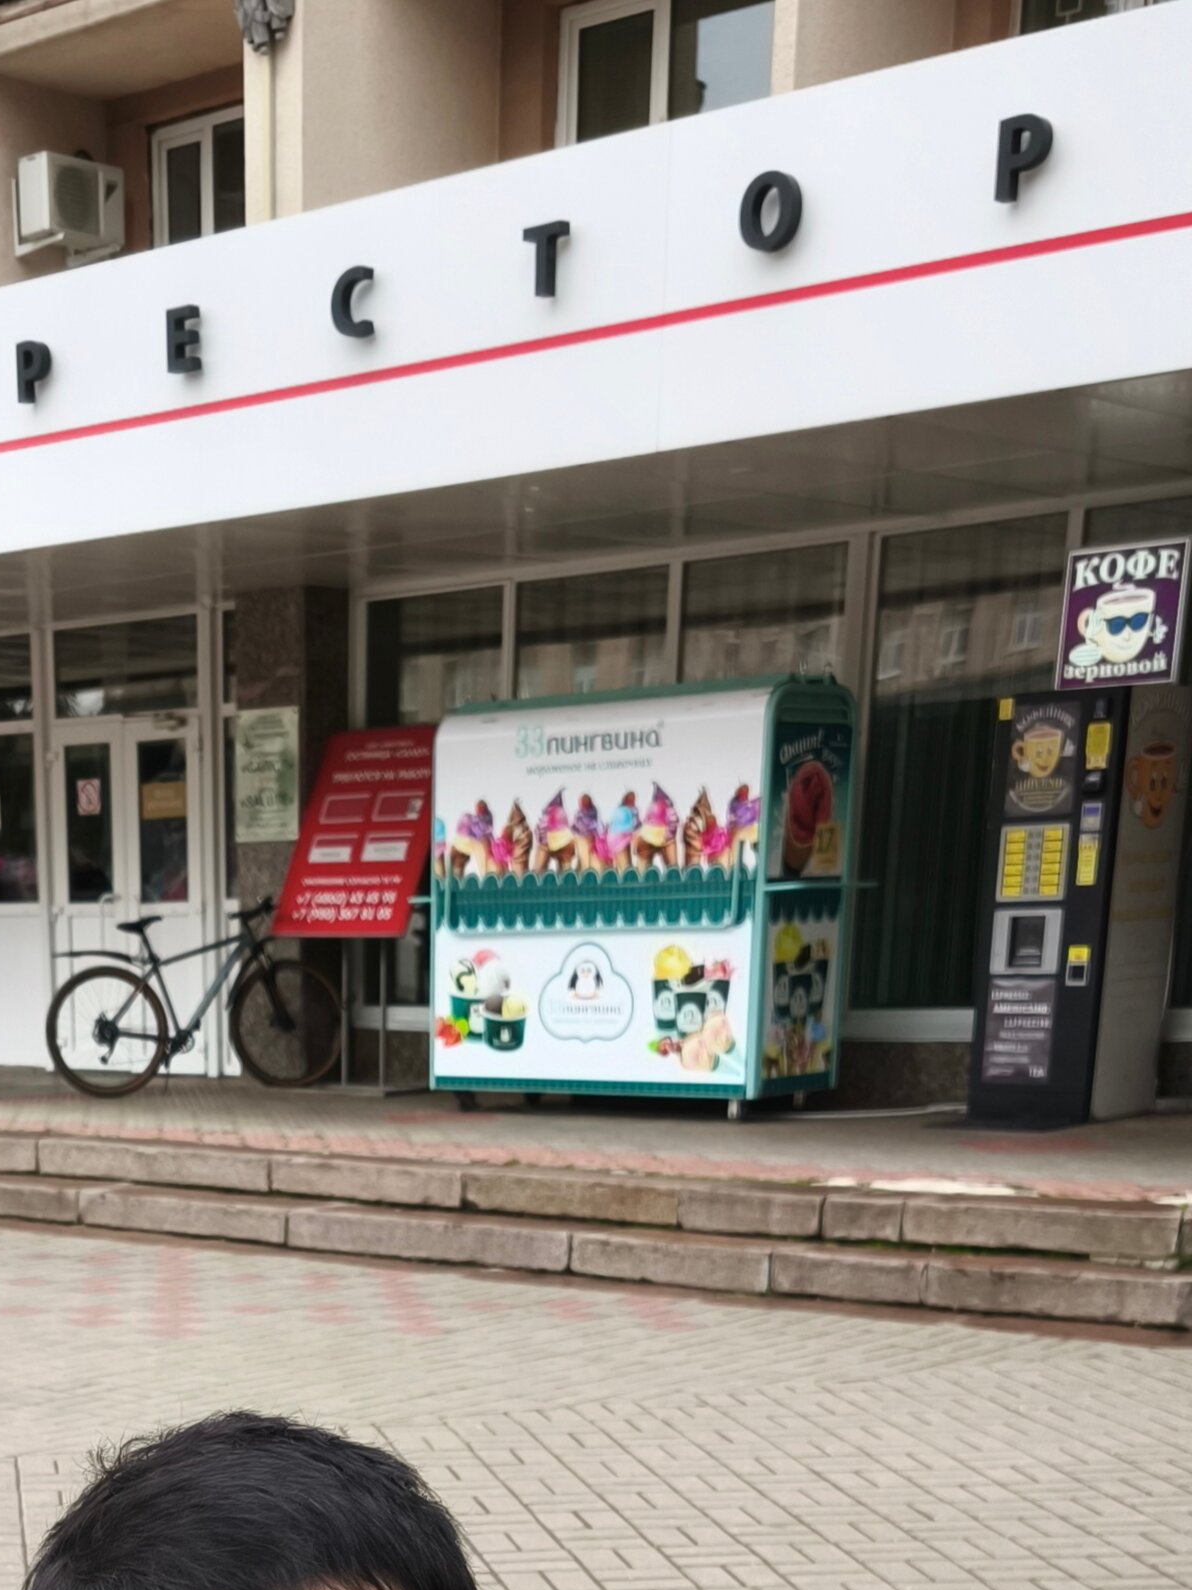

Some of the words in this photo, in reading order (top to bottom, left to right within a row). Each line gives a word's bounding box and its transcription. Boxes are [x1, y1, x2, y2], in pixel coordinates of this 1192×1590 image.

[16, 113, 1053, 404] РЕСТОР
[1073, 549, 1180, 592] КОФЕ
[1063, 651, 1167, 683] зерновой
